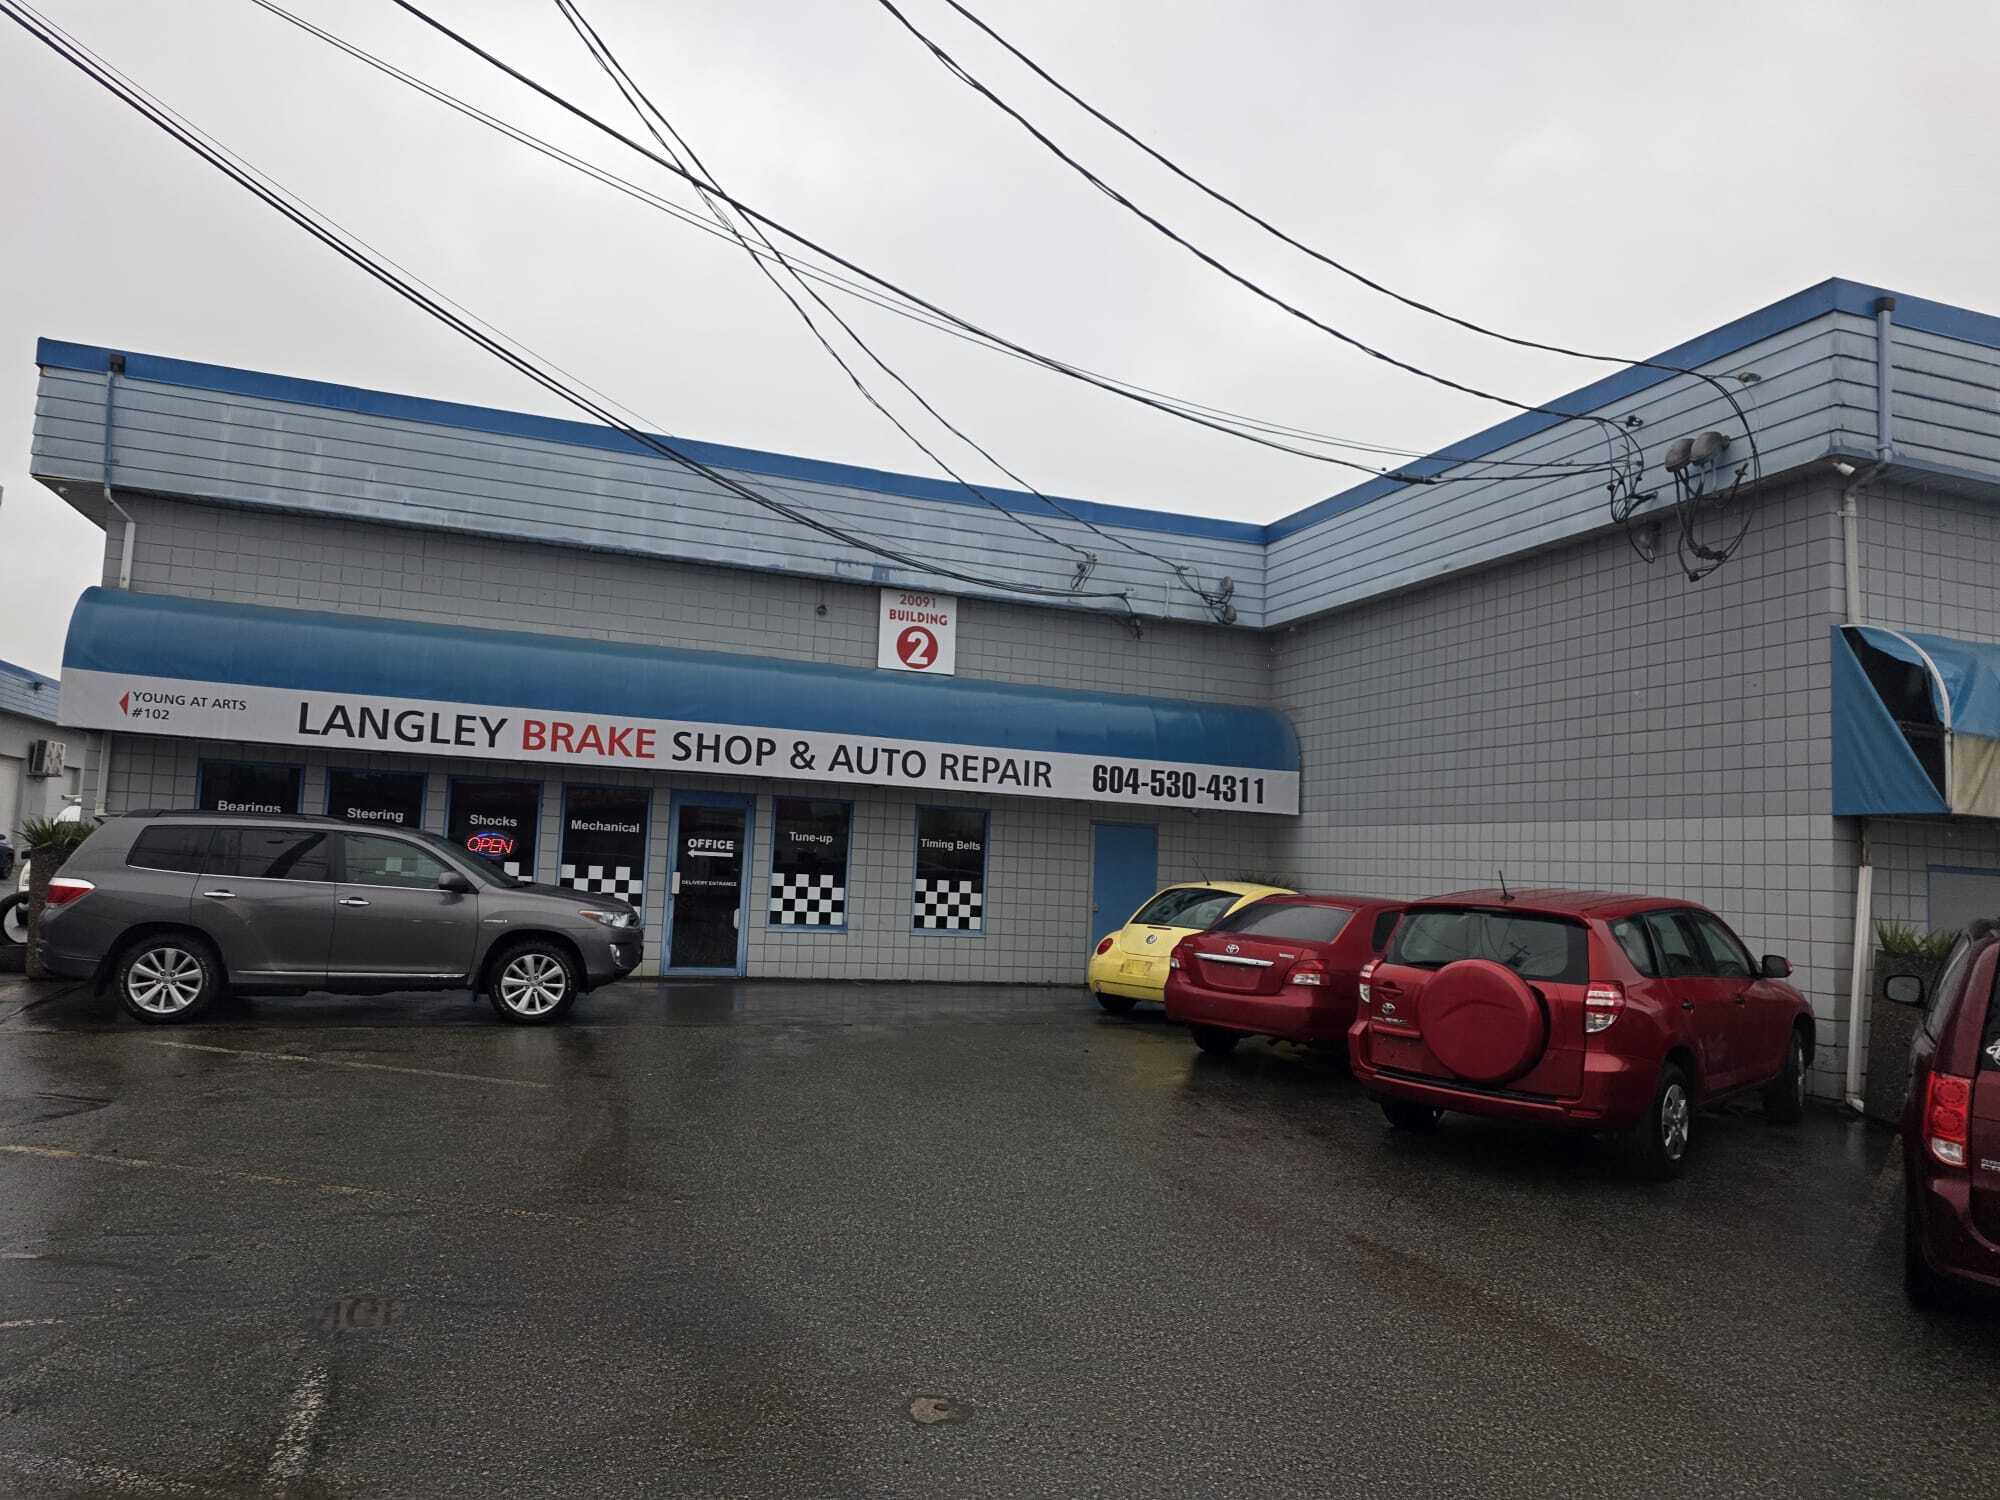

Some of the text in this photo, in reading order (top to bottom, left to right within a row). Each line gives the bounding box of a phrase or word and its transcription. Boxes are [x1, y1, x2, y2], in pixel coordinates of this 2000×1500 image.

[899, 594, 937, 608] 20091
[889, 609, 948, 626] BUILDING
[906, 631, 929, 665] 2
[133, 691, 247, 711] YOUNG AT ARTS
[132, 707, 170, 720] #102
[298, 702, 1052, 788] LANGLEY BRAKE SHOP & AUTO REPAIR
[1092, 764, 1265, 804] 604-530-4311
[217, 800, 282, 813] Bearings
[346, 808, 404, 823] Steering
[469, 814, 518, 827] Shocks
[571, 819, 641, 833] Mechanical
[687, 838, 735, 850] OFFICE
[789, 831, 833, 844] Tune-up
[920, 838, 981, 851] Timing Belts
[466, 836, 514, 855] OPEN
